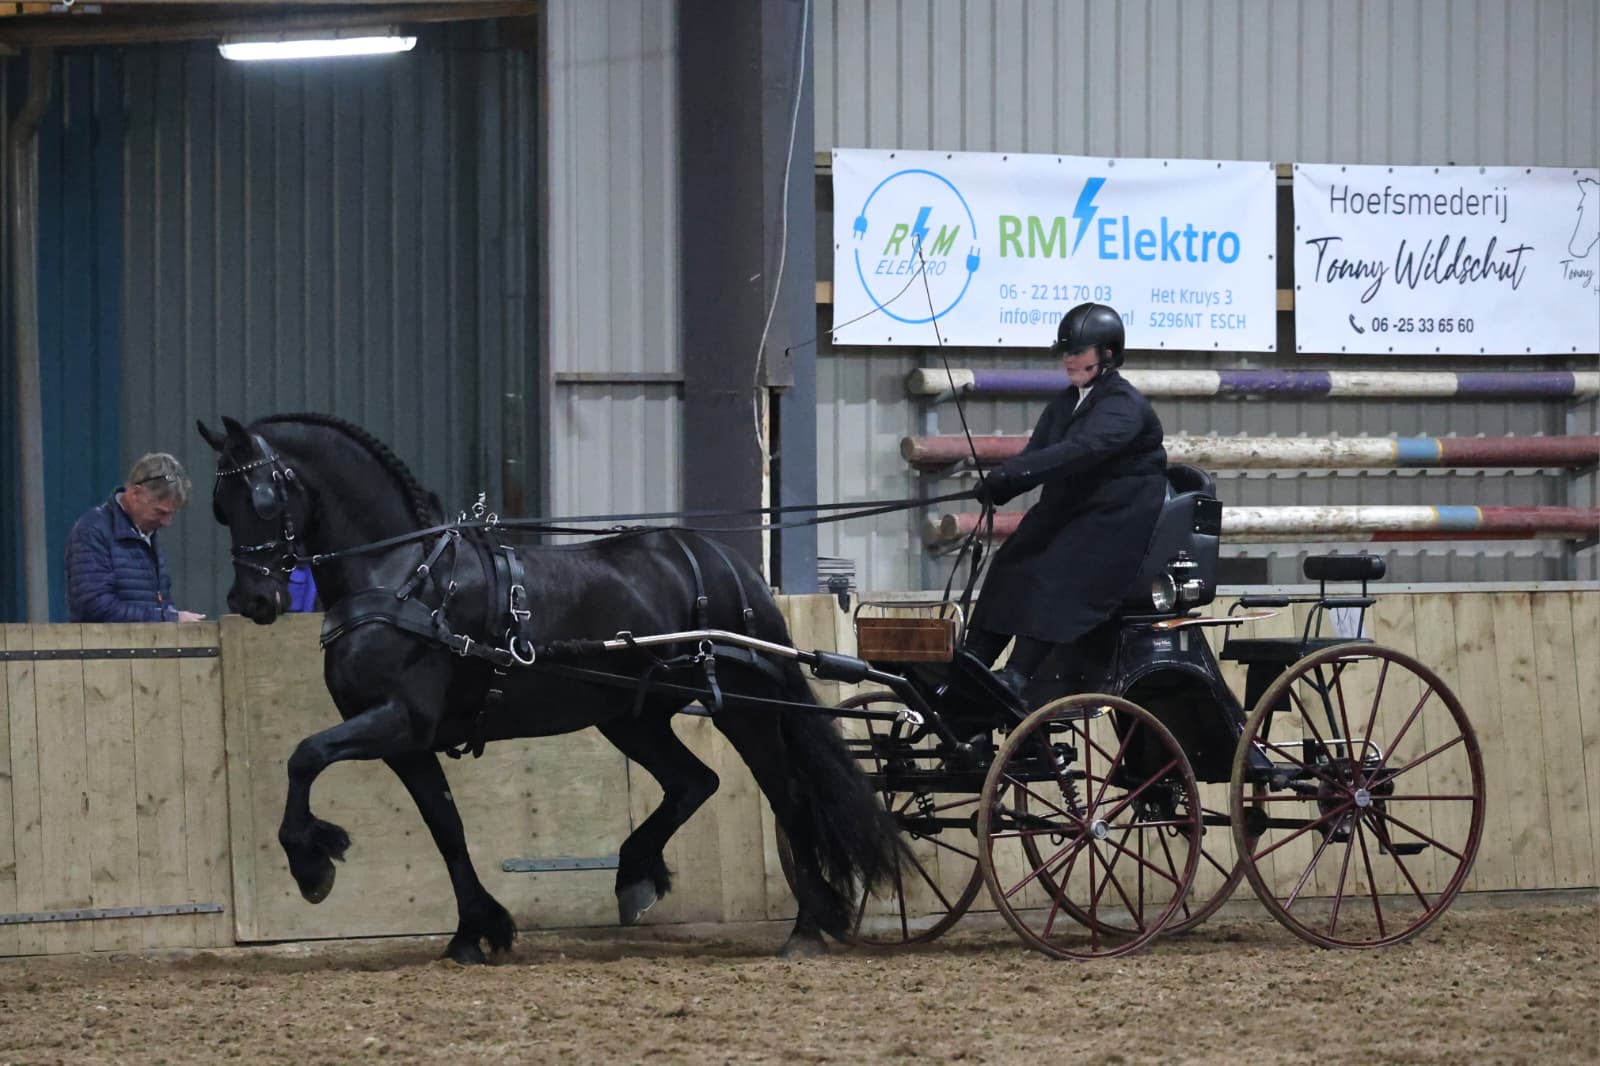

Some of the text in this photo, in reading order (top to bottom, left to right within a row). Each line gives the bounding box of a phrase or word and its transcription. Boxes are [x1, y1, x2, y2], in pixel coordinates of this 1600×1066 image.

[1330, 184, 1508, 223] Hoefsmederij
[999, 215, 1241, 264] RM Elektro
[1305, 234, 1535, 304] Tonny Wildschut
[1000, 284, 1018, 300] 06
[1031, 284, 1048, 300] 22
[1053, 285, 1069, 300] 11
[1072, 285, 1090, 301] 70
[1094, 286, 1112, 302] 03
[1151, 288, 1233, 308] Het Kruys 3
[1149, 311, 1247, 329] 5296NT ESCH
[1371, 317, 1474, 333] 06 -25 33 65 60
